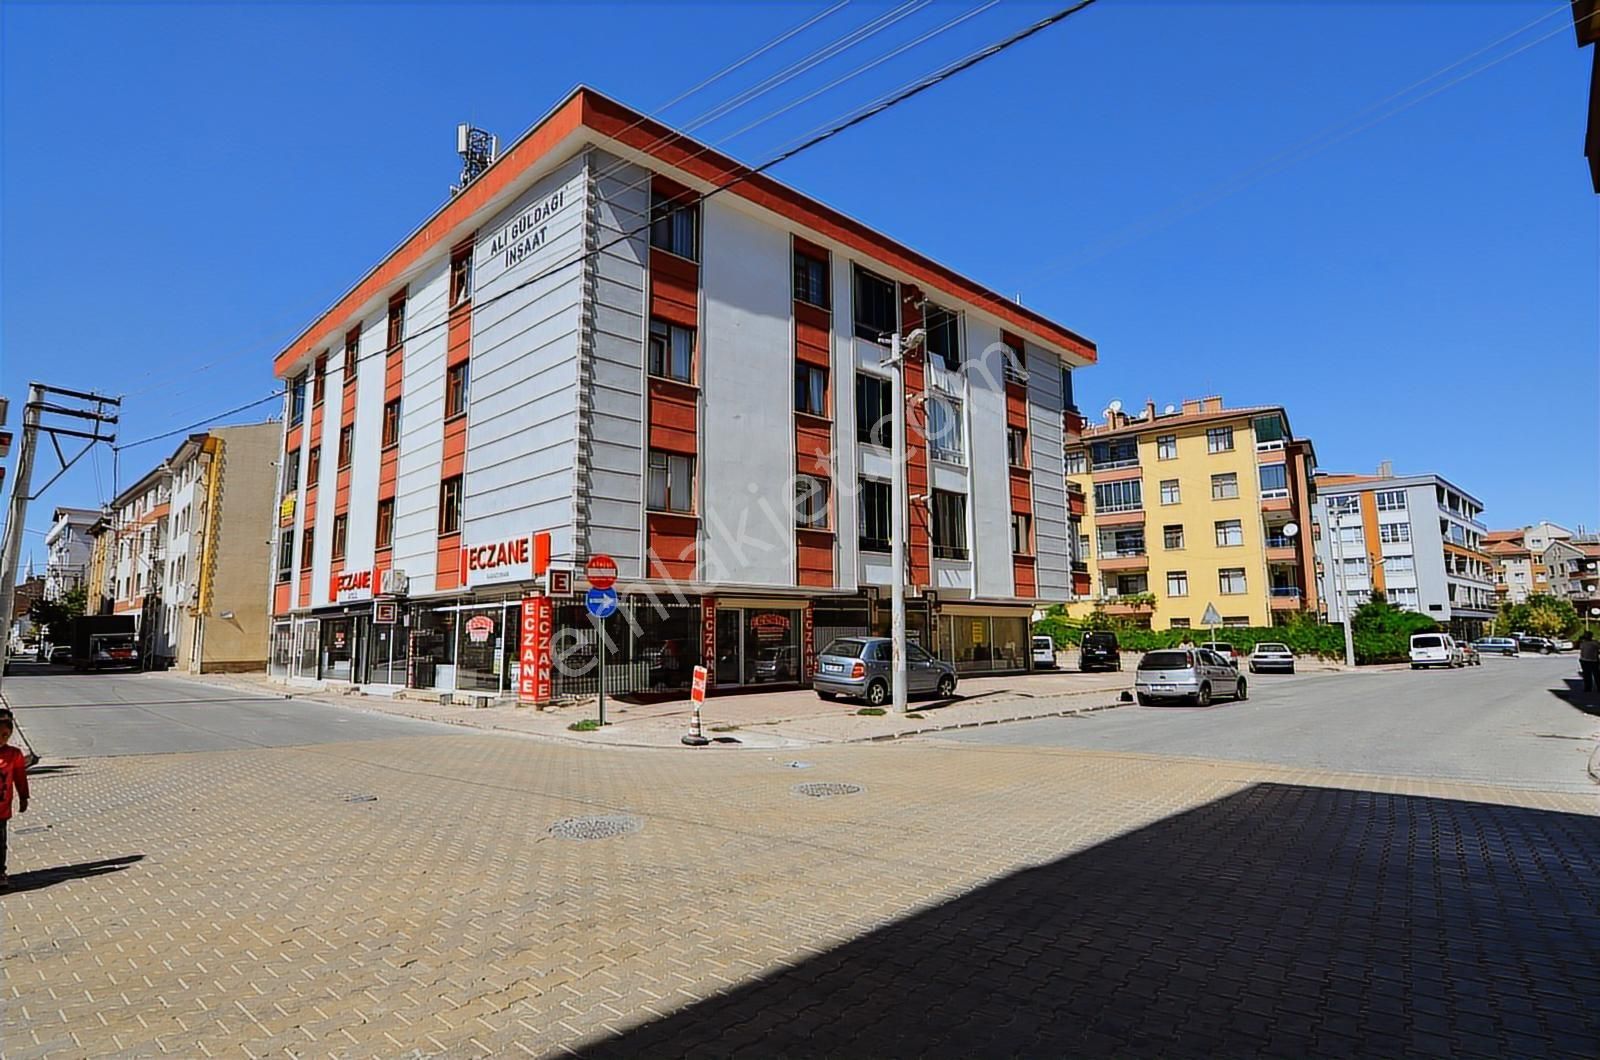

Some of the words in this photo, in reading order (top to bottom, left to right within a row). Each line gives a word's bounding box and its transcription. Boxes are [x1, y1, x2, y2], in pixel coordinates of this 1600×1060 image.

[469, 538, 529, 570] ECZANE
[522, 603, 535, 693] ECZANE
[538, 606, 550, 696] ECZANE
[705, 607, 714, 684] ECZANE
[805, 608, 814, 678] ECZANE
